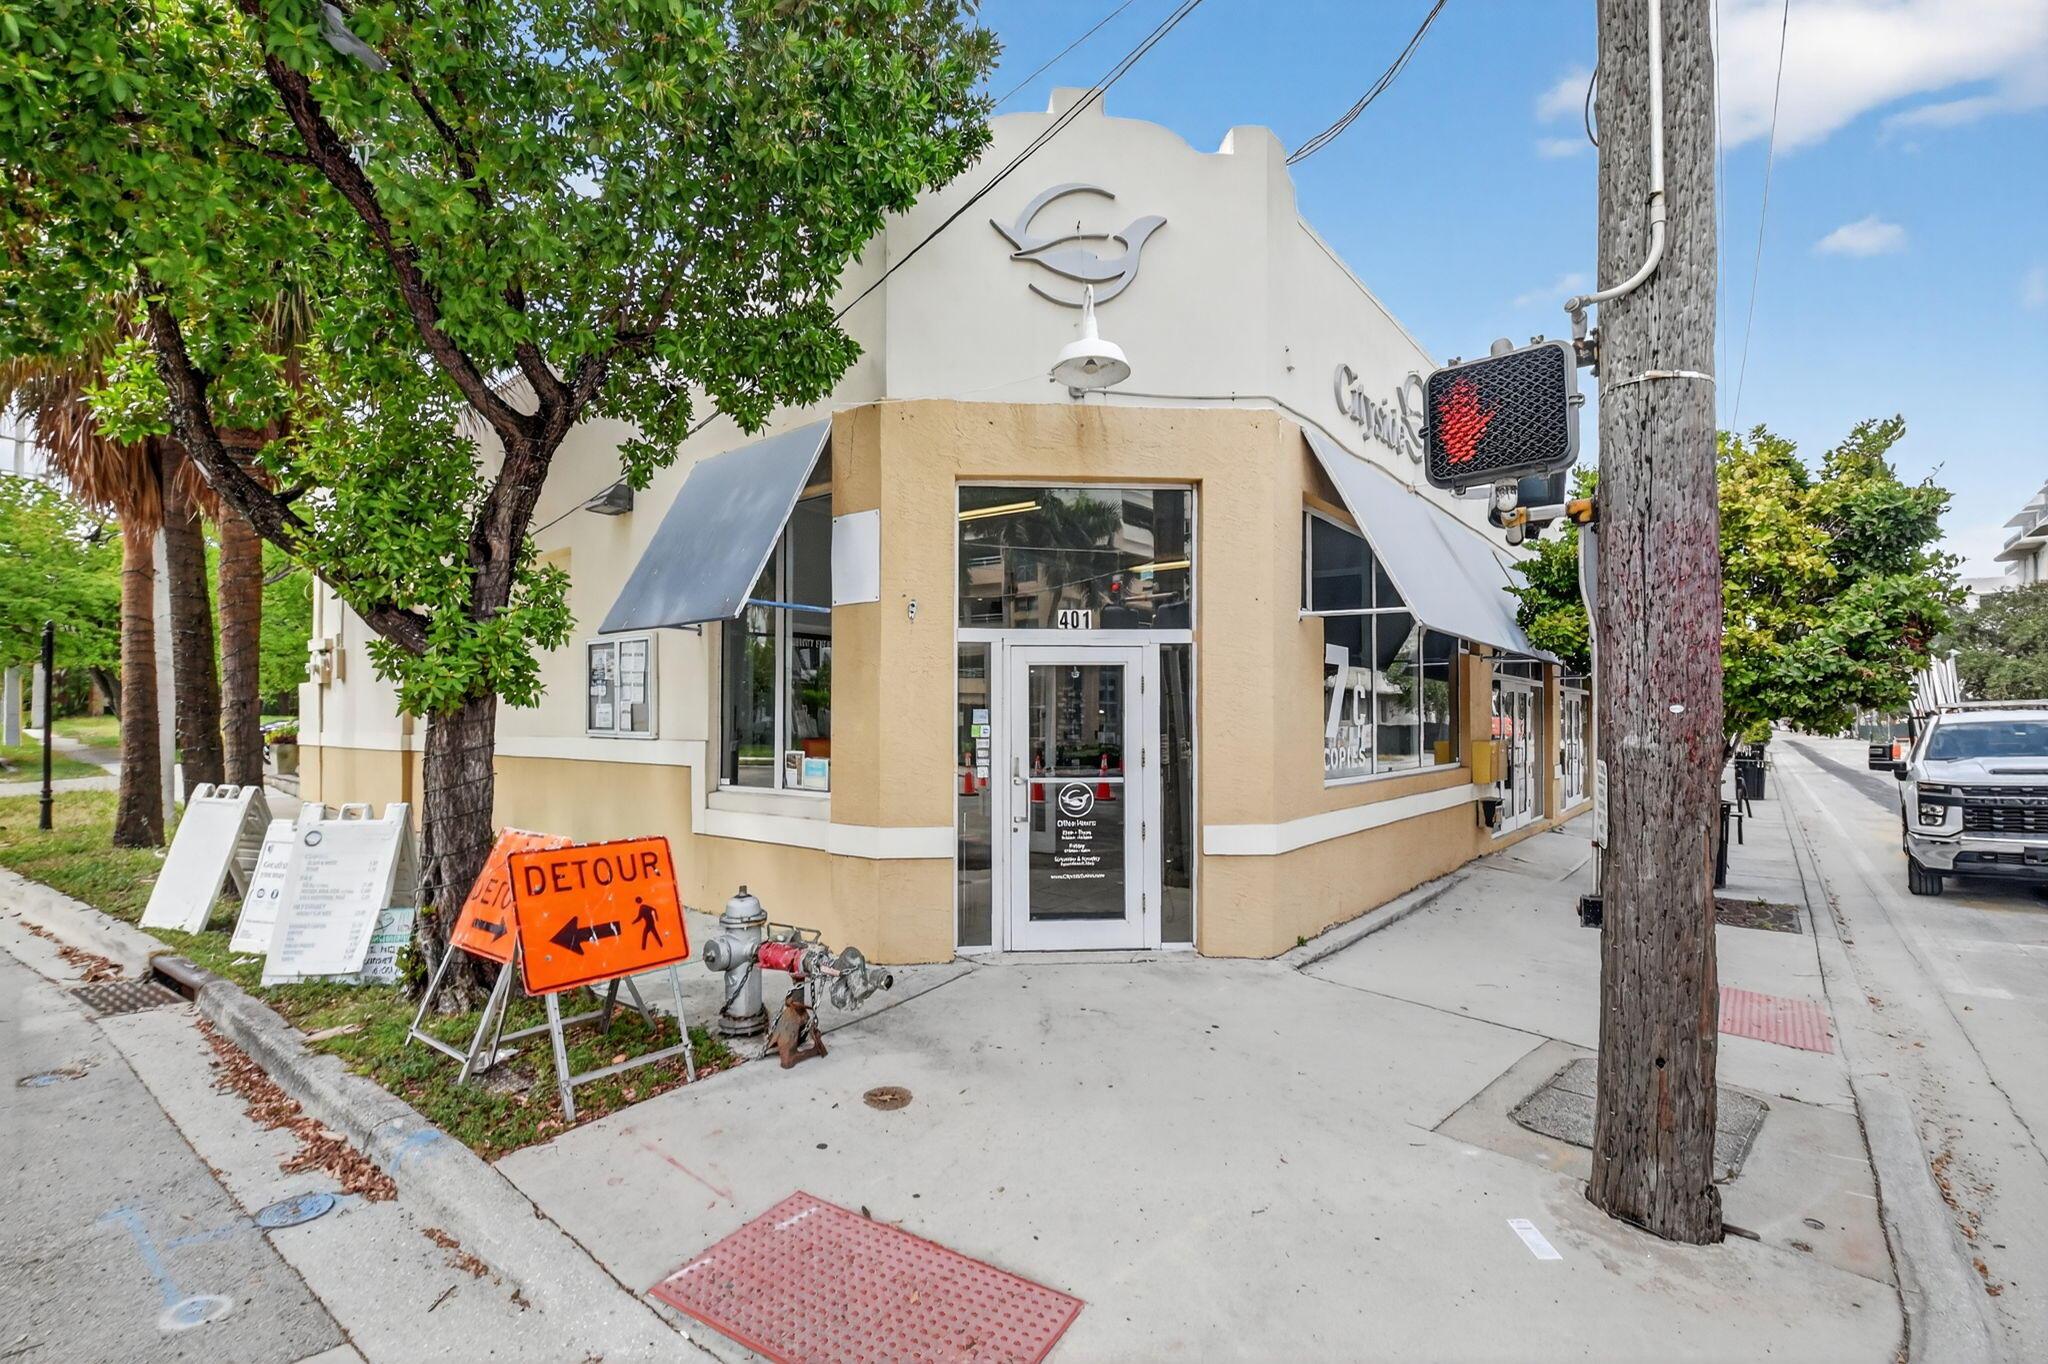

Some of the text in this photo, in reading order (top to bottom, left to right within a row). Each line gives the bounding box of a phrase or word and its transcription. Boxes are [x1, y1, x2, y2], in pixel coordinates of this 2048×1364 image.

[1060, 611, 1089, 629] 401
[1324, 746, 1366, 771] COPIES
[525, 851, 661, 896] DETOUR
